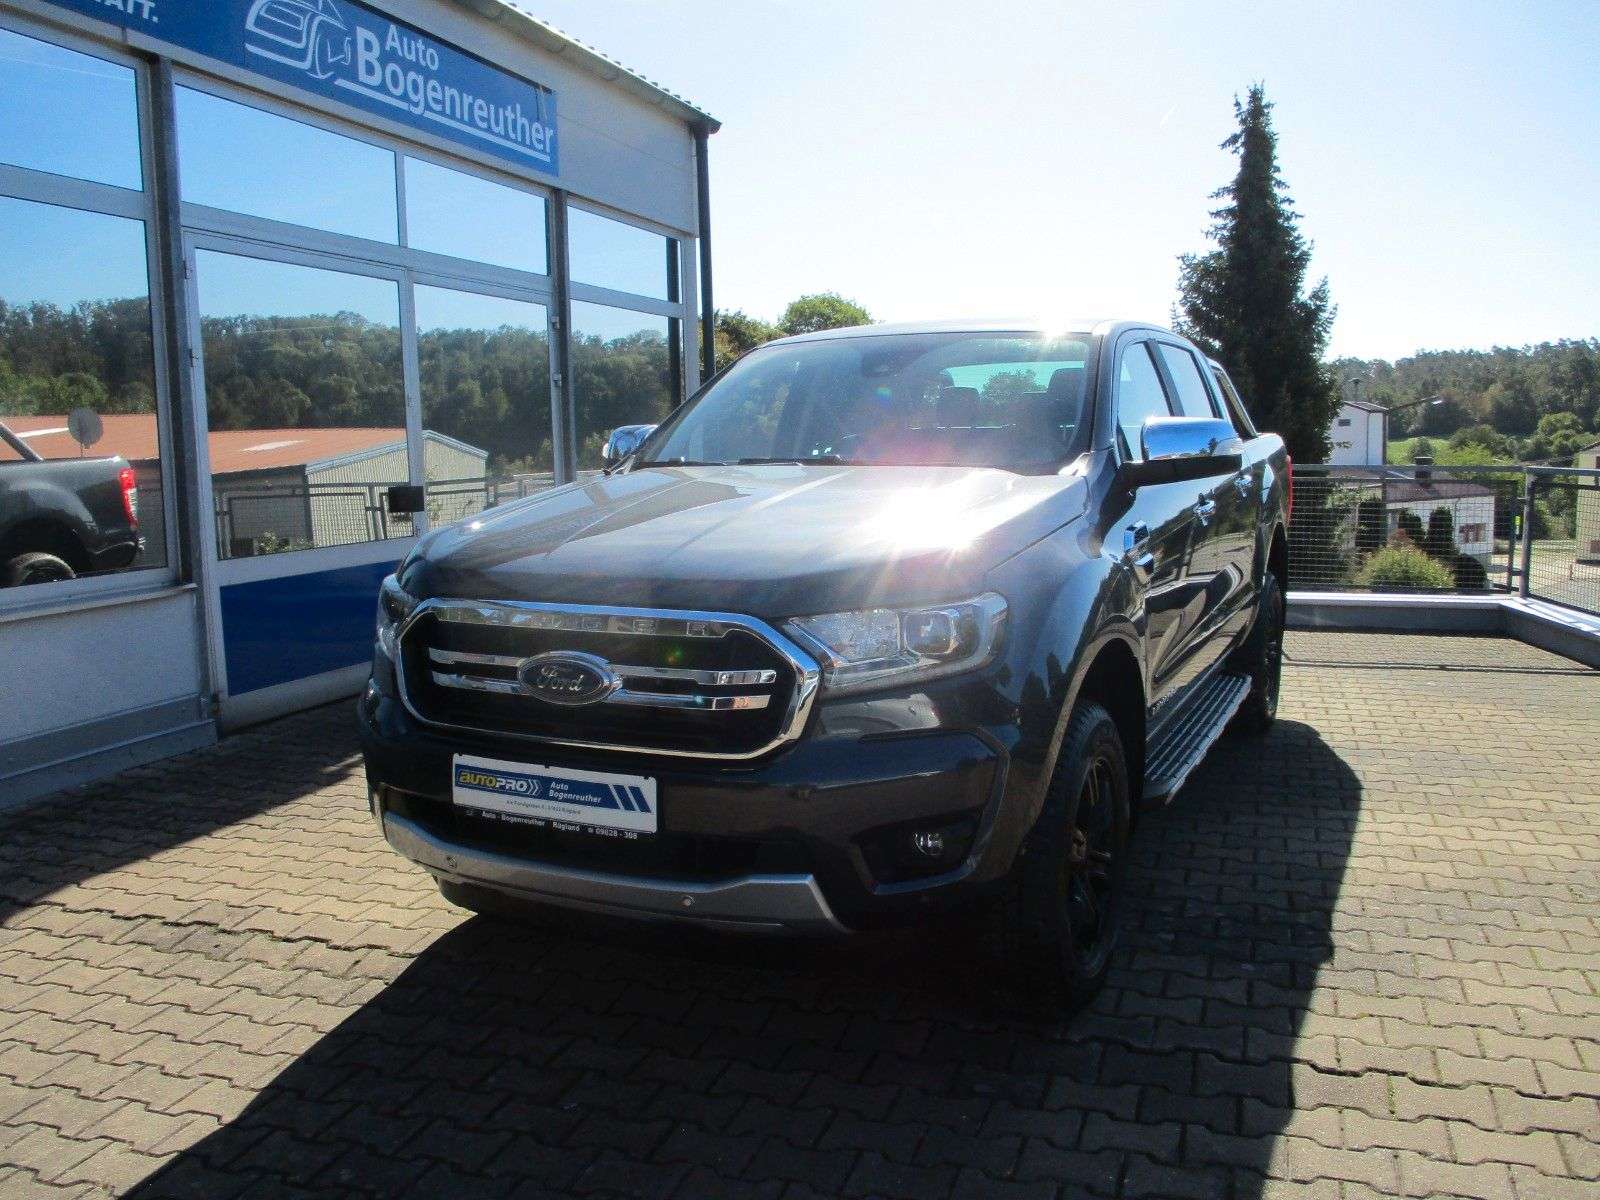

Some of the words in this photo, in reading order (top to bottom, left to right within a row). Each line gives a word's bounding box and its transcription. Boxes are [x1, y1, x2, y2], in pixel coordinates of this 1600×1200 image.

[385, 24, 440, 71] Auto
[356, 26, 554, 154] Bogenreuther
[536, 664, 585, 692] Ford
[549, 790, 602, 803] Bogenreuther
[550, 781, 569, 791] Auto
[501, 813, 546, 827] Bogenreuther
